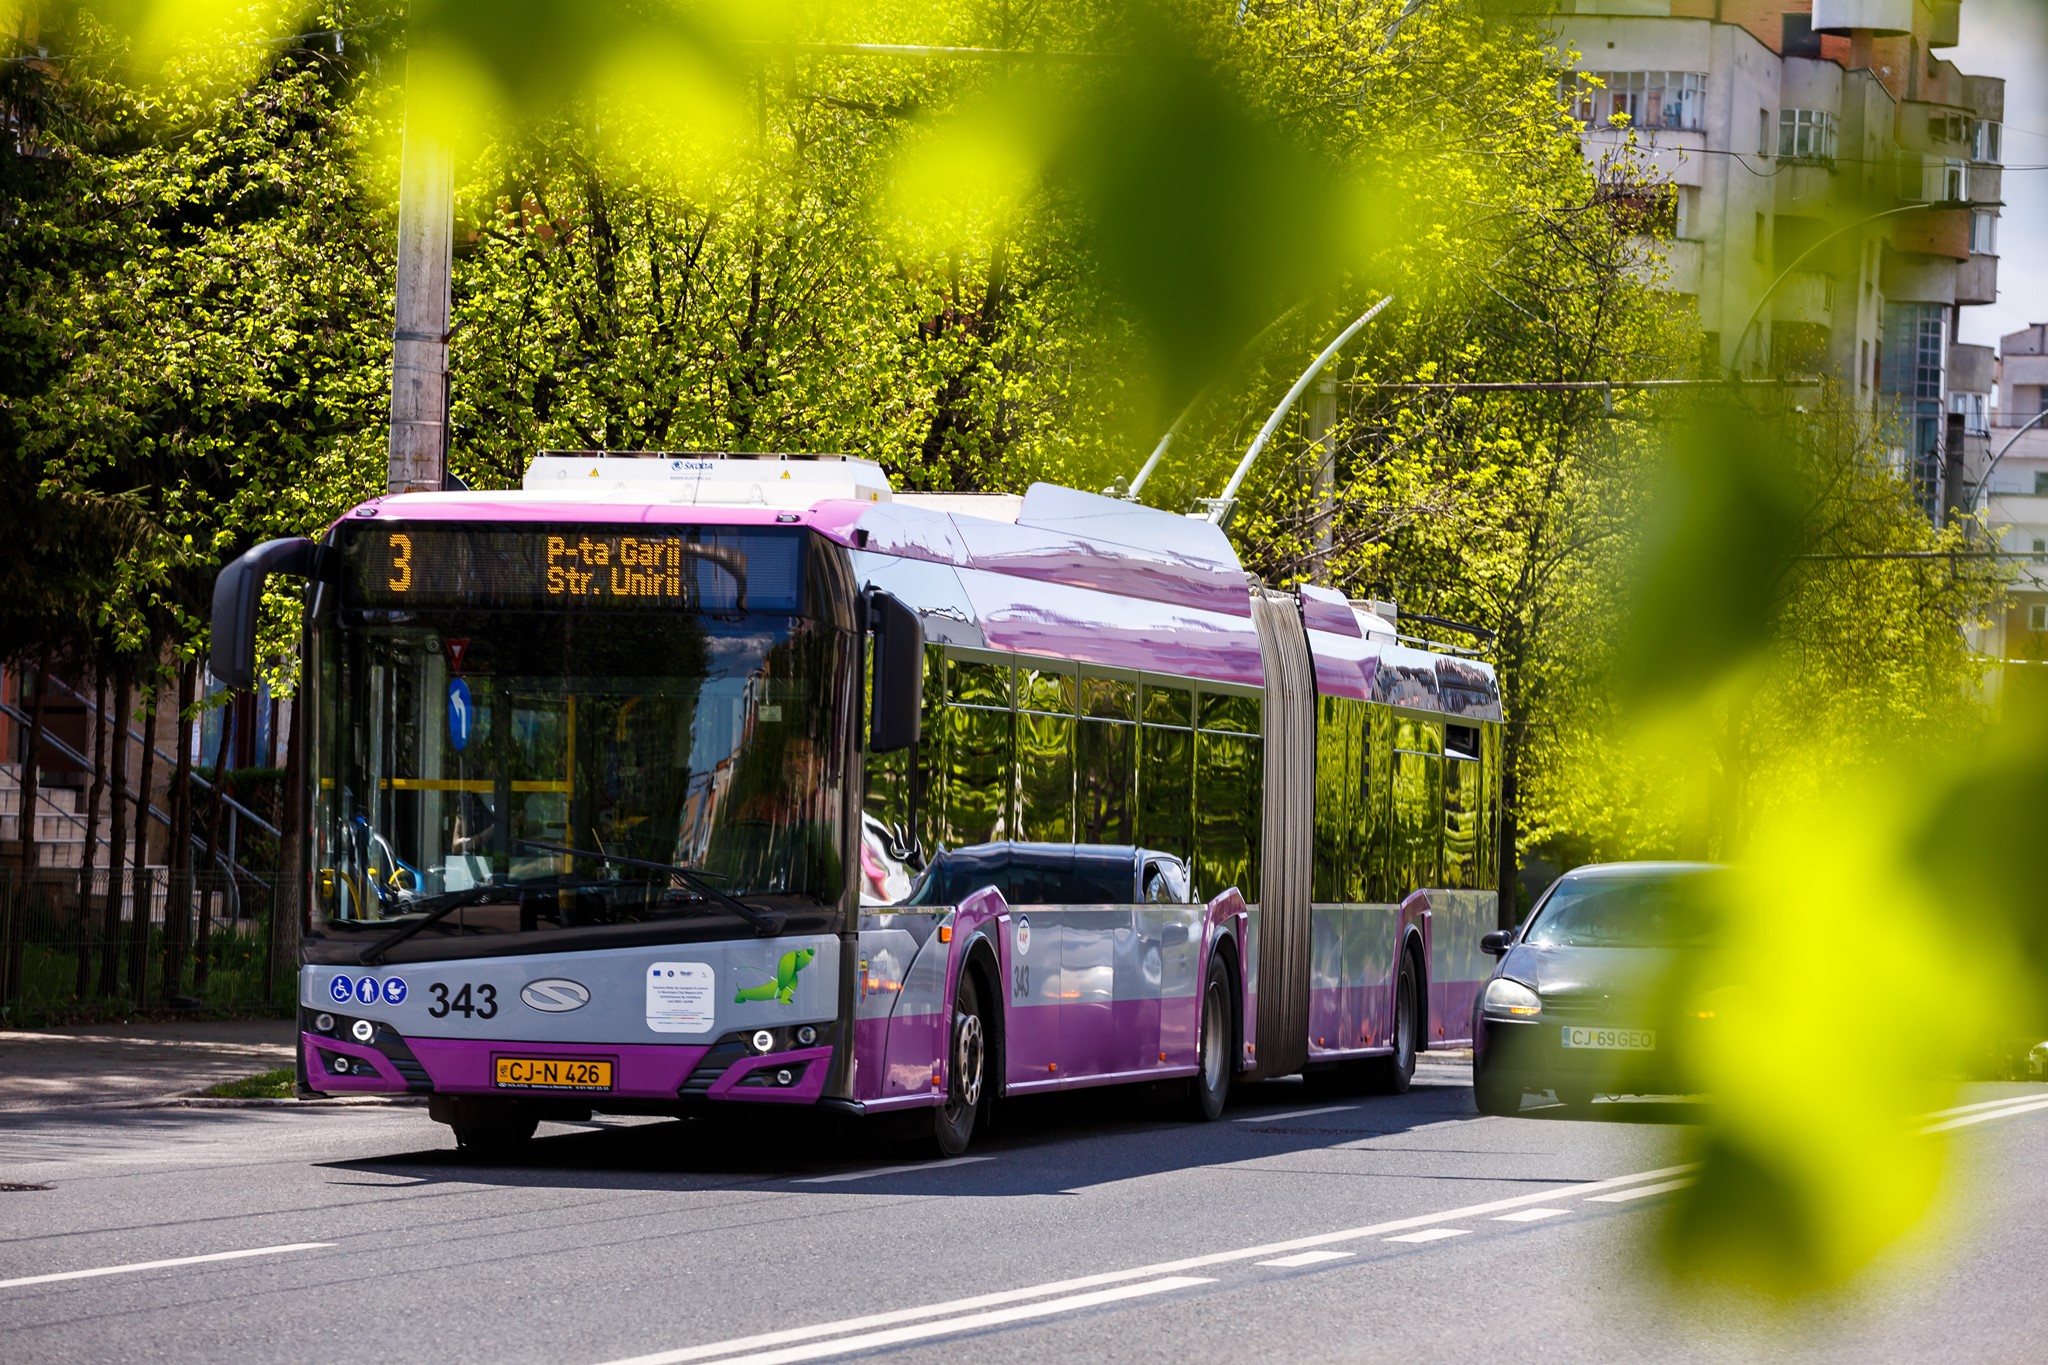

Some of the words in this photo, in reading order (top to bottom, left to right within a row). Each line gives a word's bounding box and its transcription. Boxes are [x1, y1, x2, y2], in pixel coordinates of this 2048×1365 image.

[389, 534, 412, 592] 3
[547, 536, 609, 565] P-ta
[620, 537, 680, 566] Garii
[547, 566, 600, 595] Str.
[611, 567, 680, 596] Unirii
[1014, 965, 1030, 998] 343
[428, 982, 498, 1019] 343
[1572, 1030, 1592, 1046] CJ
[1597, 1031, 1616, 1047] 69
[510, 1062, 558, 1082] CJ-N
[565, 1064, 600, 1083] 426
